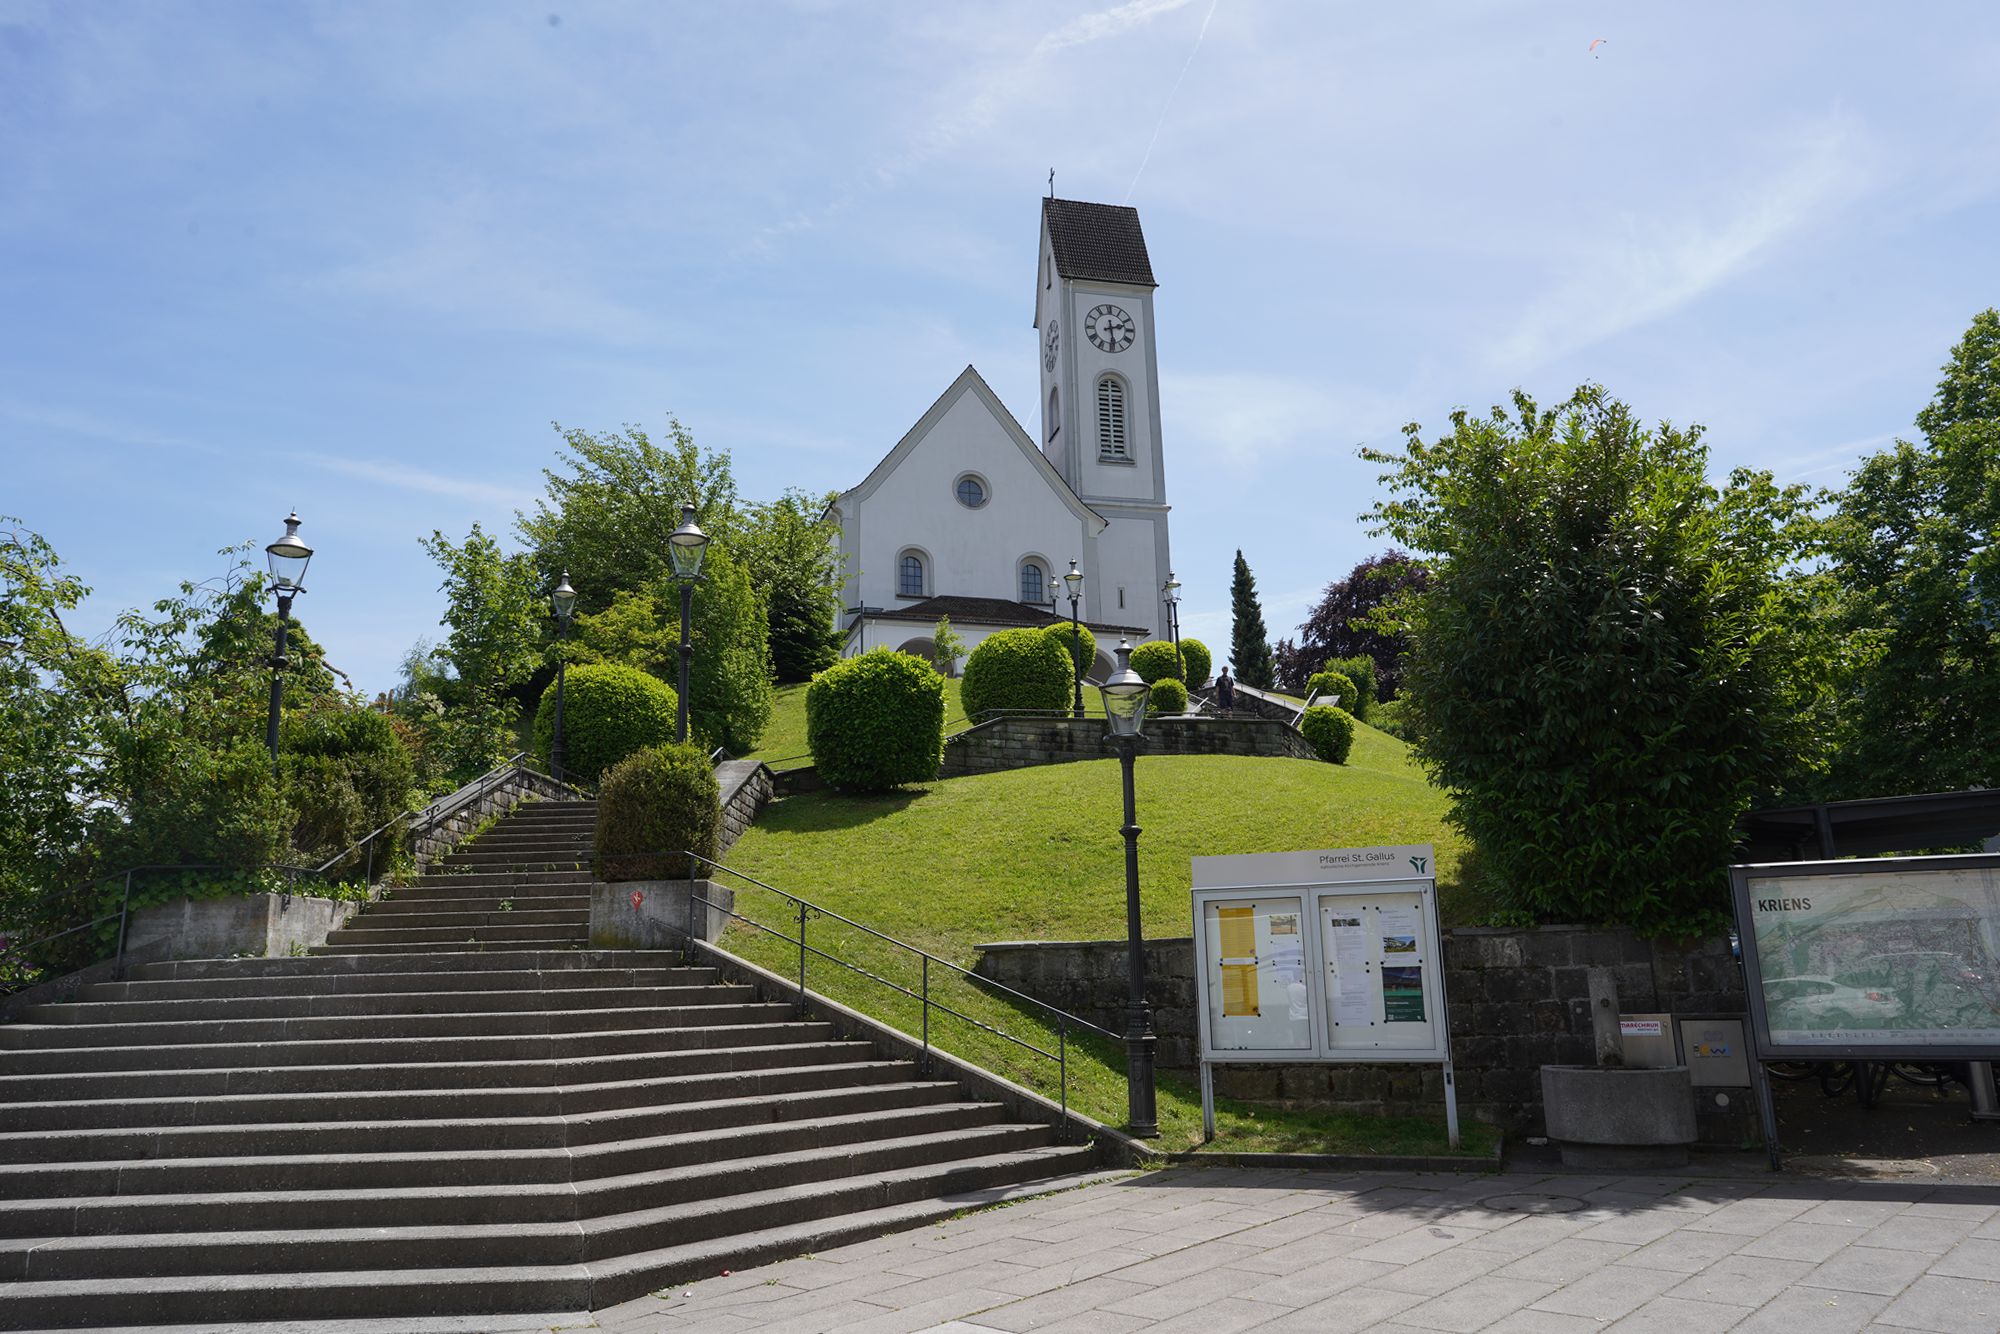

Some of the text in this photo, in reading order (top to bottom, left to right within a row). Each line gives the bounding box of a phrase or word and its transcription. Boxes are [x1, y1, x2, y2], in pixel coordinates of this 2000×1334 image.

[1319, 852, 1395, 864] Pfarrei St. Gallus
[1758, 898, 1811, 911] KRIENS
